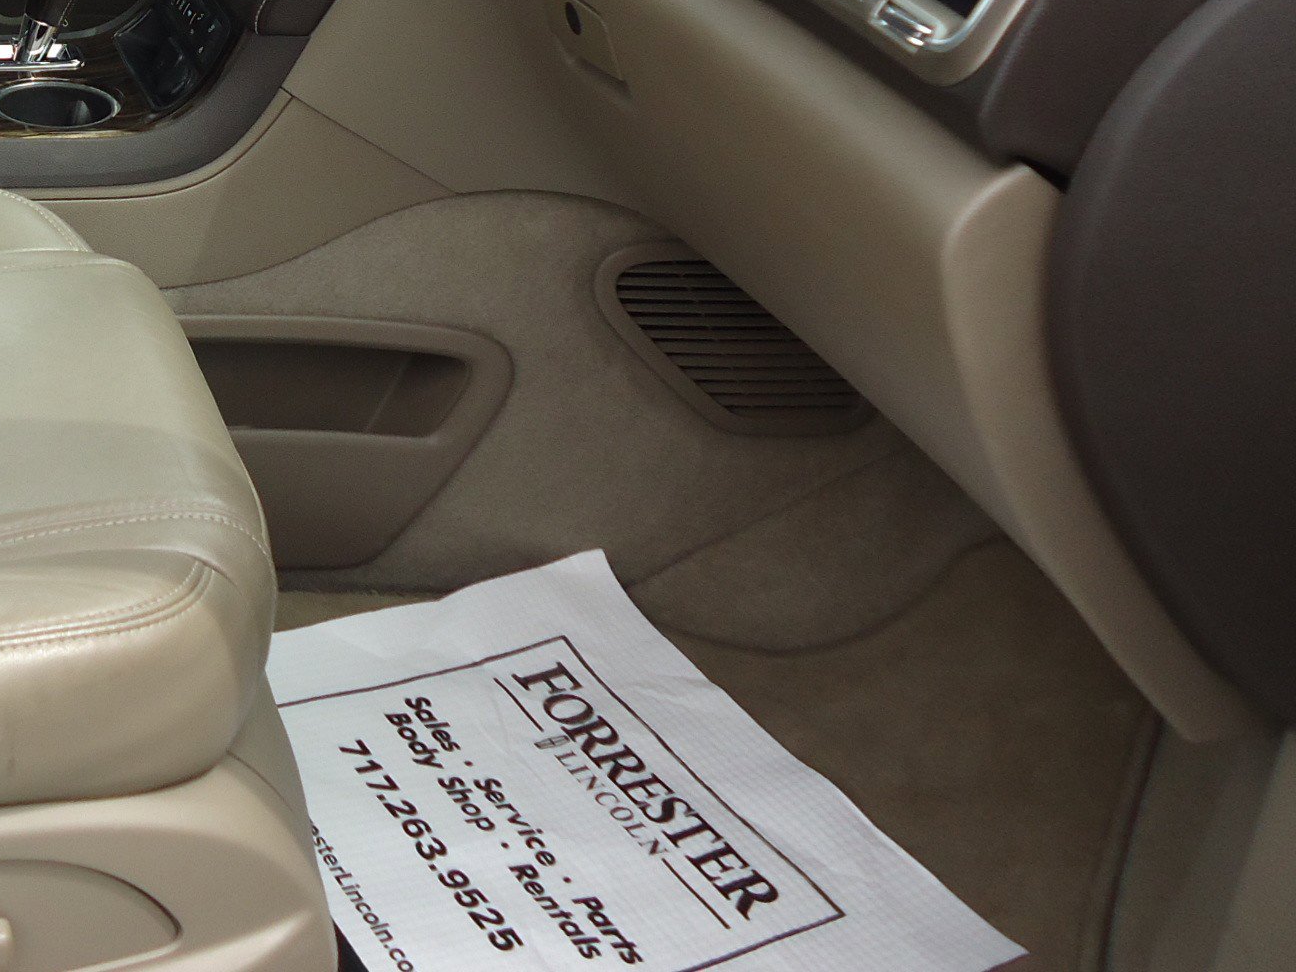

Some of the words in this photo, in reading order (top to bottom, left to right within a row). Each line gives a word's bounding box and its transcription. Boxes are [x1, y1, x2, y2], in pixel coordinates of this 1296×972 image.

[338, 739, 525, 952] 717.263.9525
[384, 712, 445, 769] Body
[437, 775, 496, 832] Shop
[507, 863, 602, 960] Rentals
[404, 696, 461, 753] Sales
[473, 777, 557, 867] Service
[572, 896, 644, 965] Parts
[511, 661, 779, 921] FORRESTER
[554, 750, 669, 856] LINCOLN
